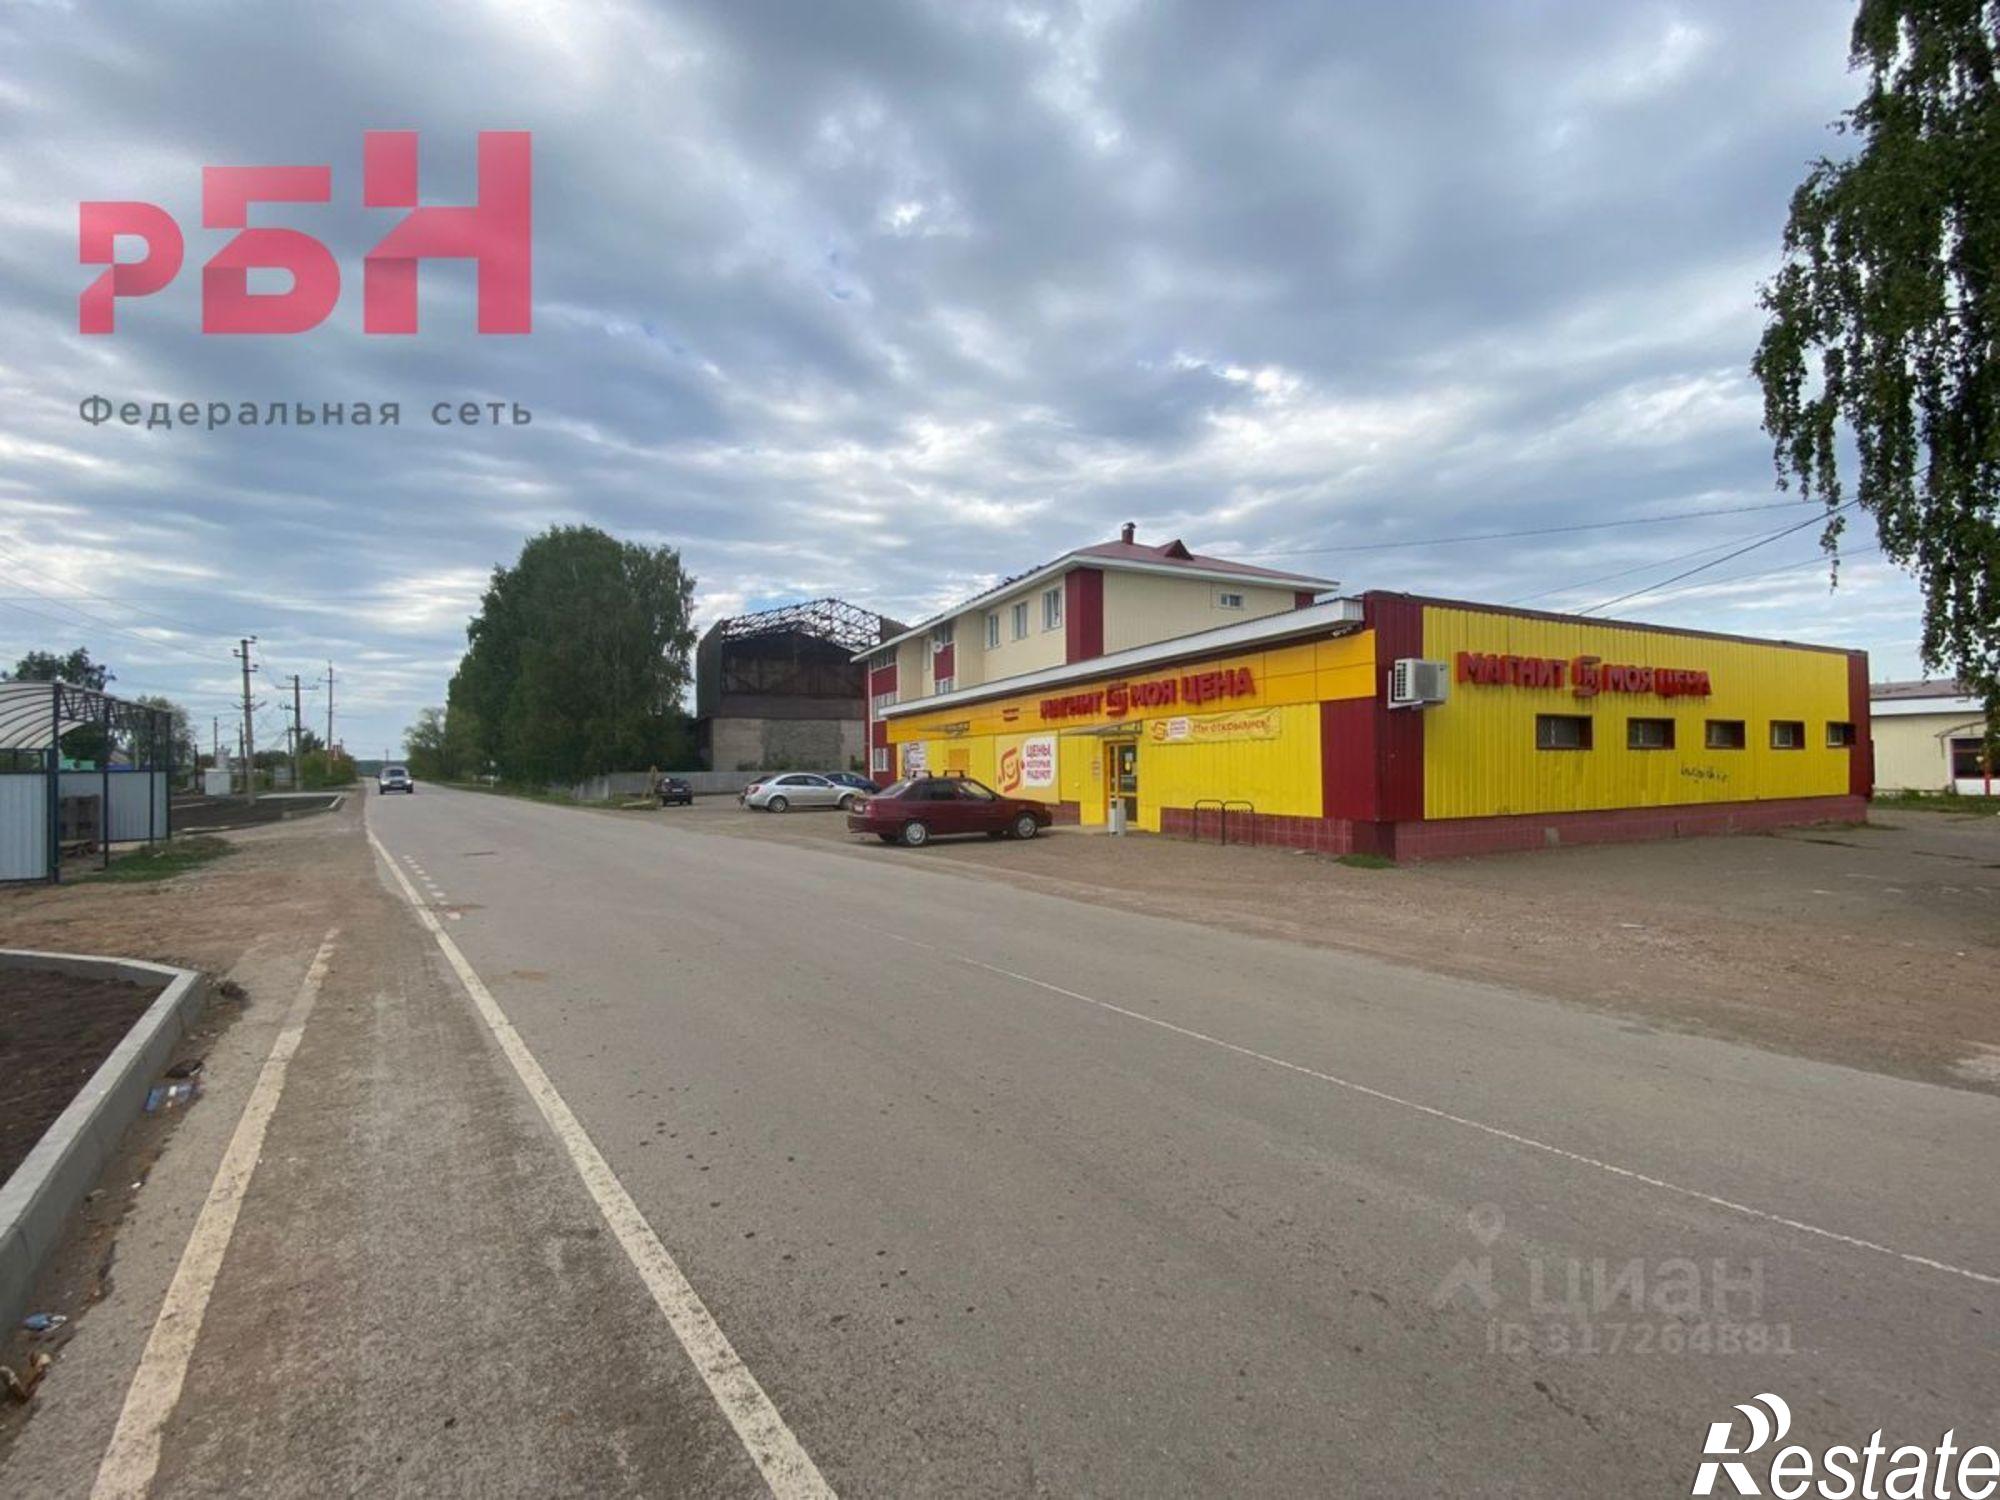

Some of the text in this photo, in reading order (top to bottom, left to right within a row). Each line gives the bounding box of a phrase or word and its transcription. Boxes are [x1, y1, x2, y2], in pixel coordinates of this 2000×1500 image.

[1040, 691, 1104, 719] МАГНИТ
[1130, 679, 1177, 708] МОЯ
[1182, 667, 1256, 705] ЦЕНА
[1456, 651, 1711, 698] МАГНИТ МОЯ ЦЕНА
